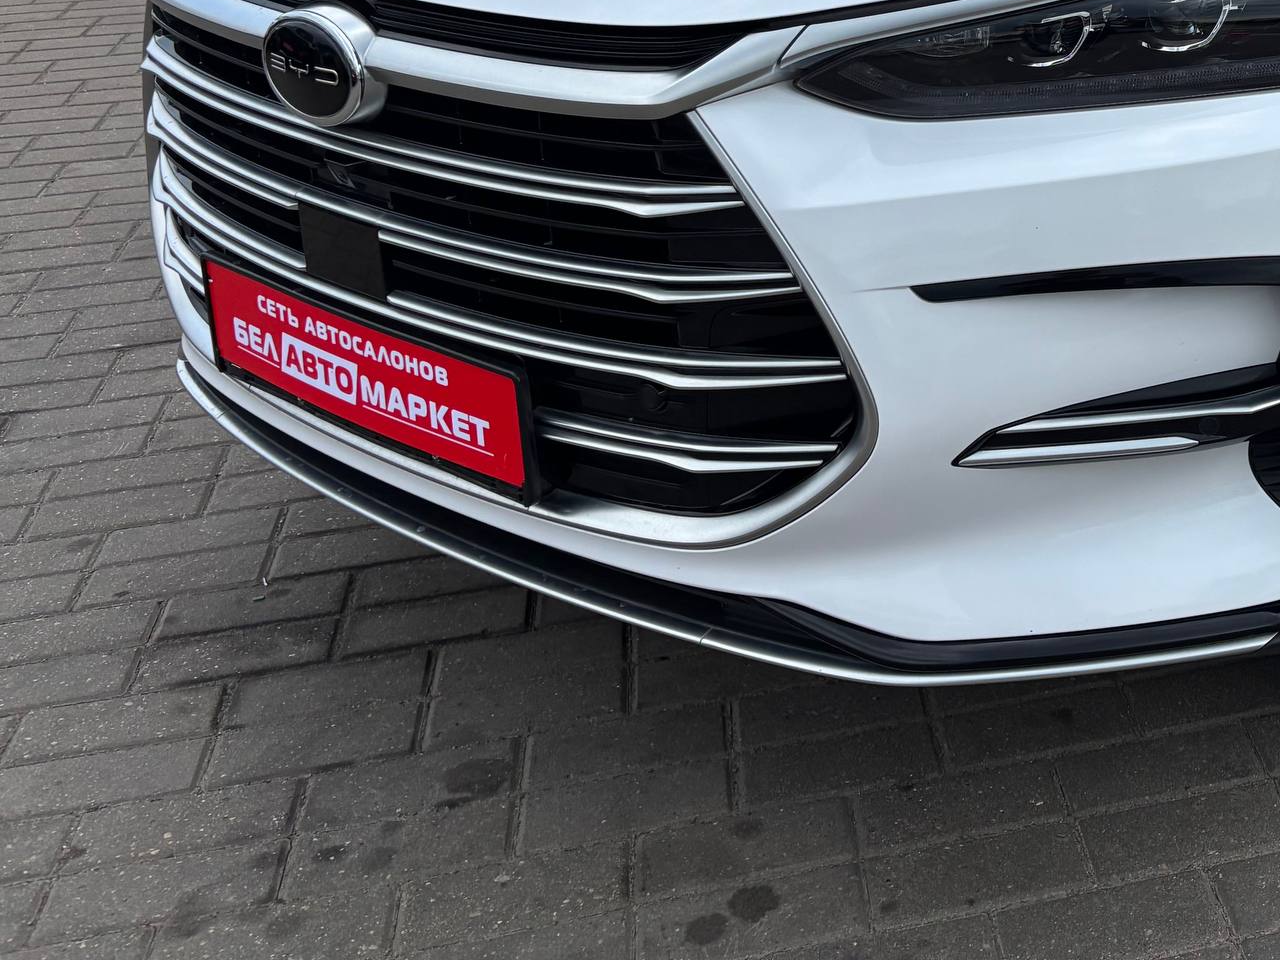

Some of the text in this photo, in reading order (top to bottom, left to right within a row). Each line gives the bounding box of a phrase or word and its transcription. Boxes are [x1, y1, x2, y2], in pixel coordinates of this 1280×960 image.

[270, 52, 339, 86] BYD
[256, 294, 449, 387] СЕТЬ АВТОСАЛОНОВ
